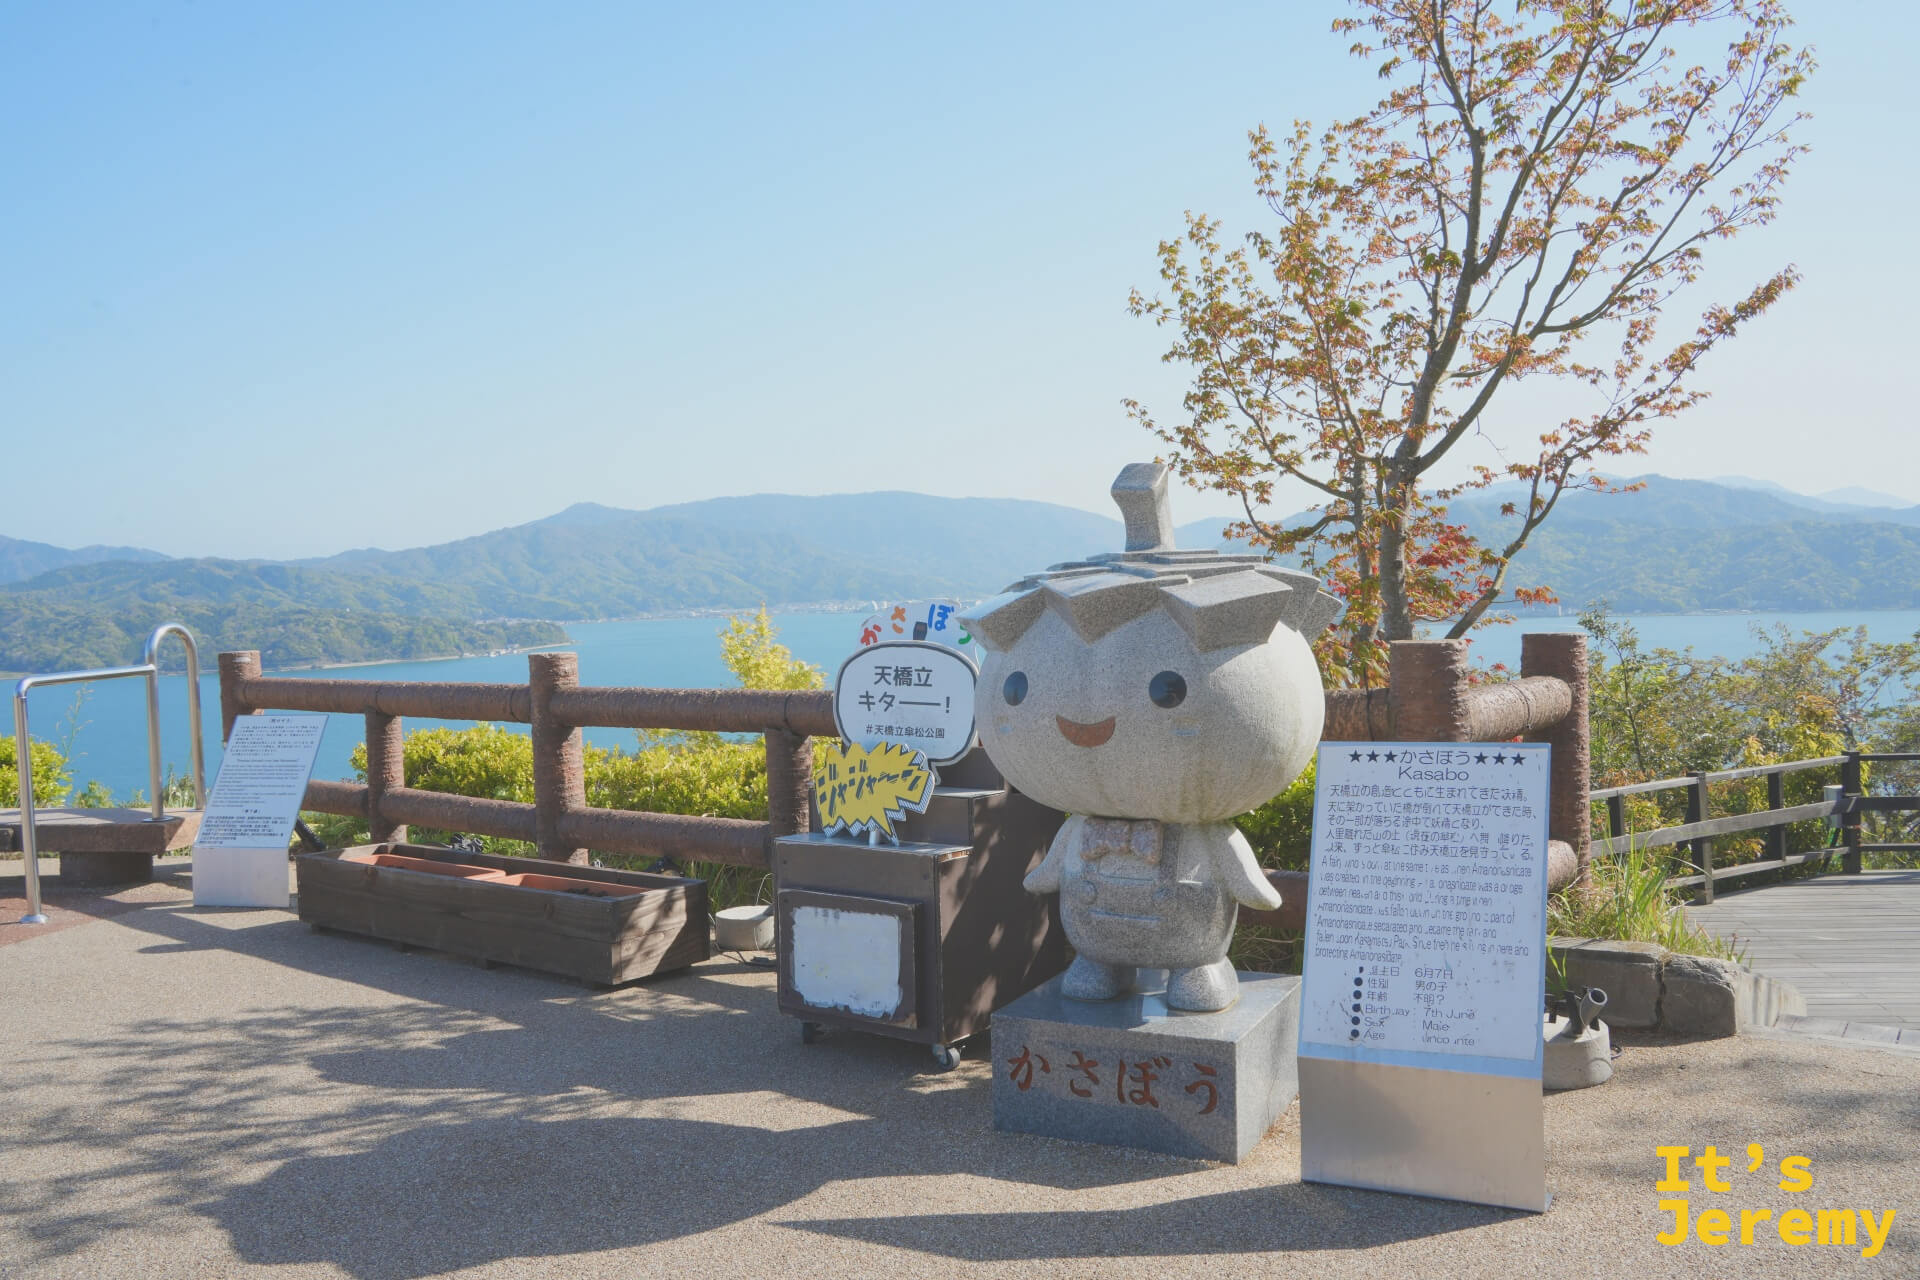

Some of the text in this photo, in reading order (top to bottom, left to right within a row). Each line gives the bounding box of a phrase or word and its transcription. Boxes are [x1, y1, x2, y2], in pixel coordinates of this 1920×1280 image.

[873, 665, 933, 687] 天橋立
[865, 723, 945, 740] #天橋立傘松公園
[1398, 765, 1469, 781] Kasabo
[1367, 977, 1448, 992] 性別 男の子
[1367, 990, 1387, 1001] 年齢
[1423, 1006, 1443, 1018] 7th
[1363, 1027, 1385, 1040] Age
[1007, 1045, 1219, 1115] かさぼう
